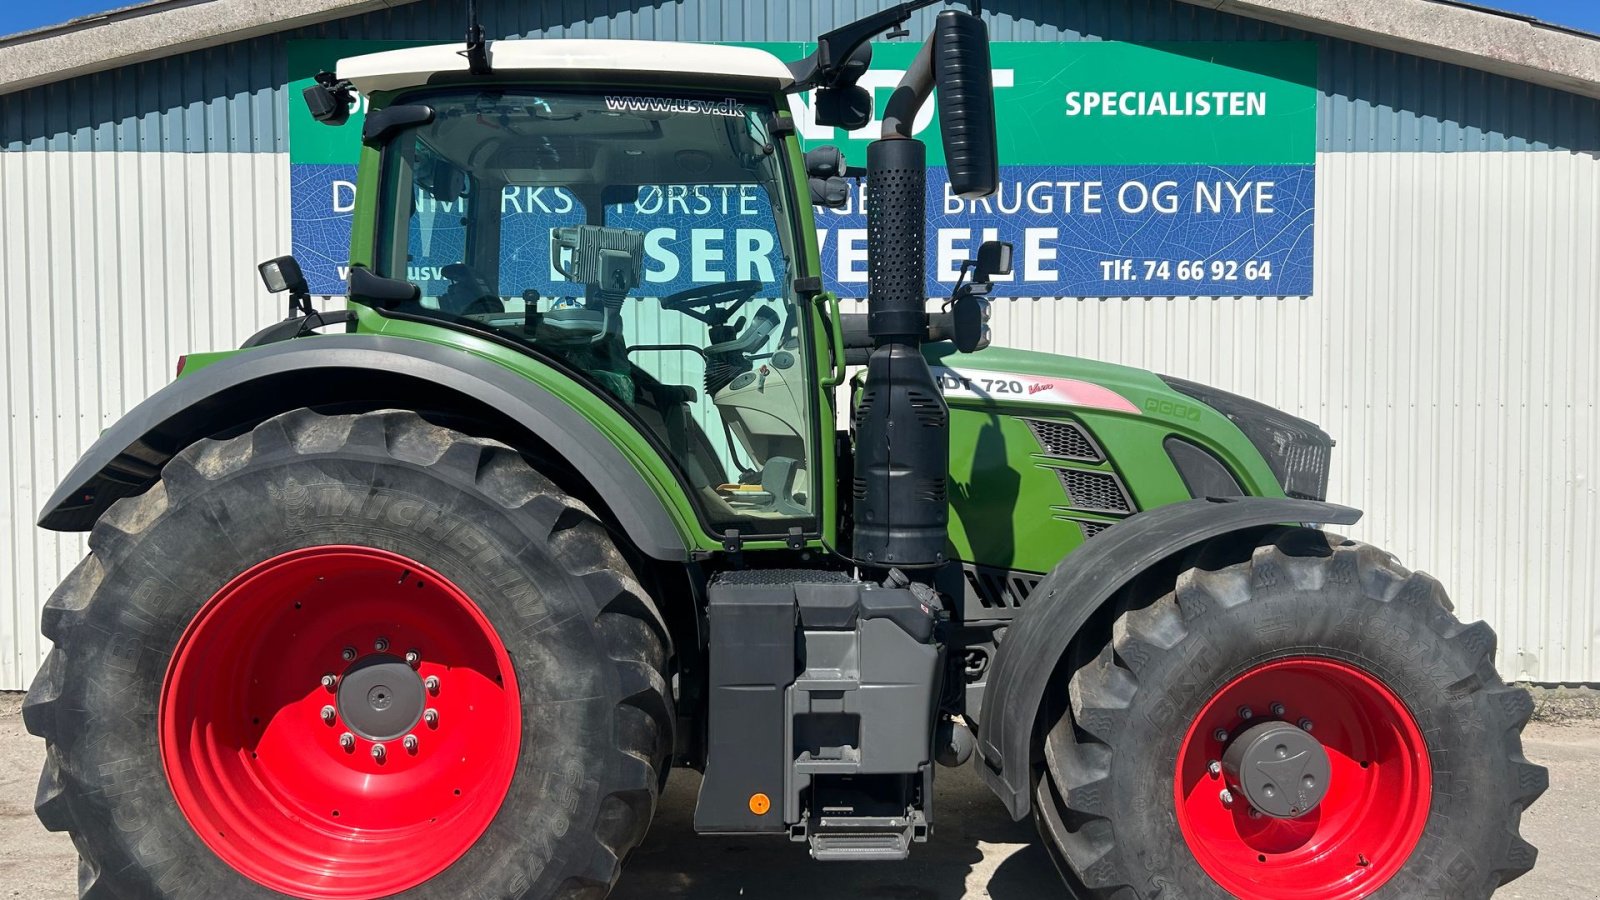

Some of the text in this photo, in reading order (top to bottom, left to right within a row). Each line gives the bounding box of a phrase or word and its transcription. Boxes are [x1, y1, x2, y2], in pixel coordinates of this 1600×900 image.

[605, 96, 746, 117] www.usv.dk
[1065, 91, 1266, 116] SPECIALISTEN
[1117, 181, 1179, 214] OG
[1195, 181, 1275, 214] NYE
[1100, 260, 1272, 281] Tlf. 74 66 92 64
[981, 378, 1023, 394] 720
[322, 483, 552, 622] MICHELIN
